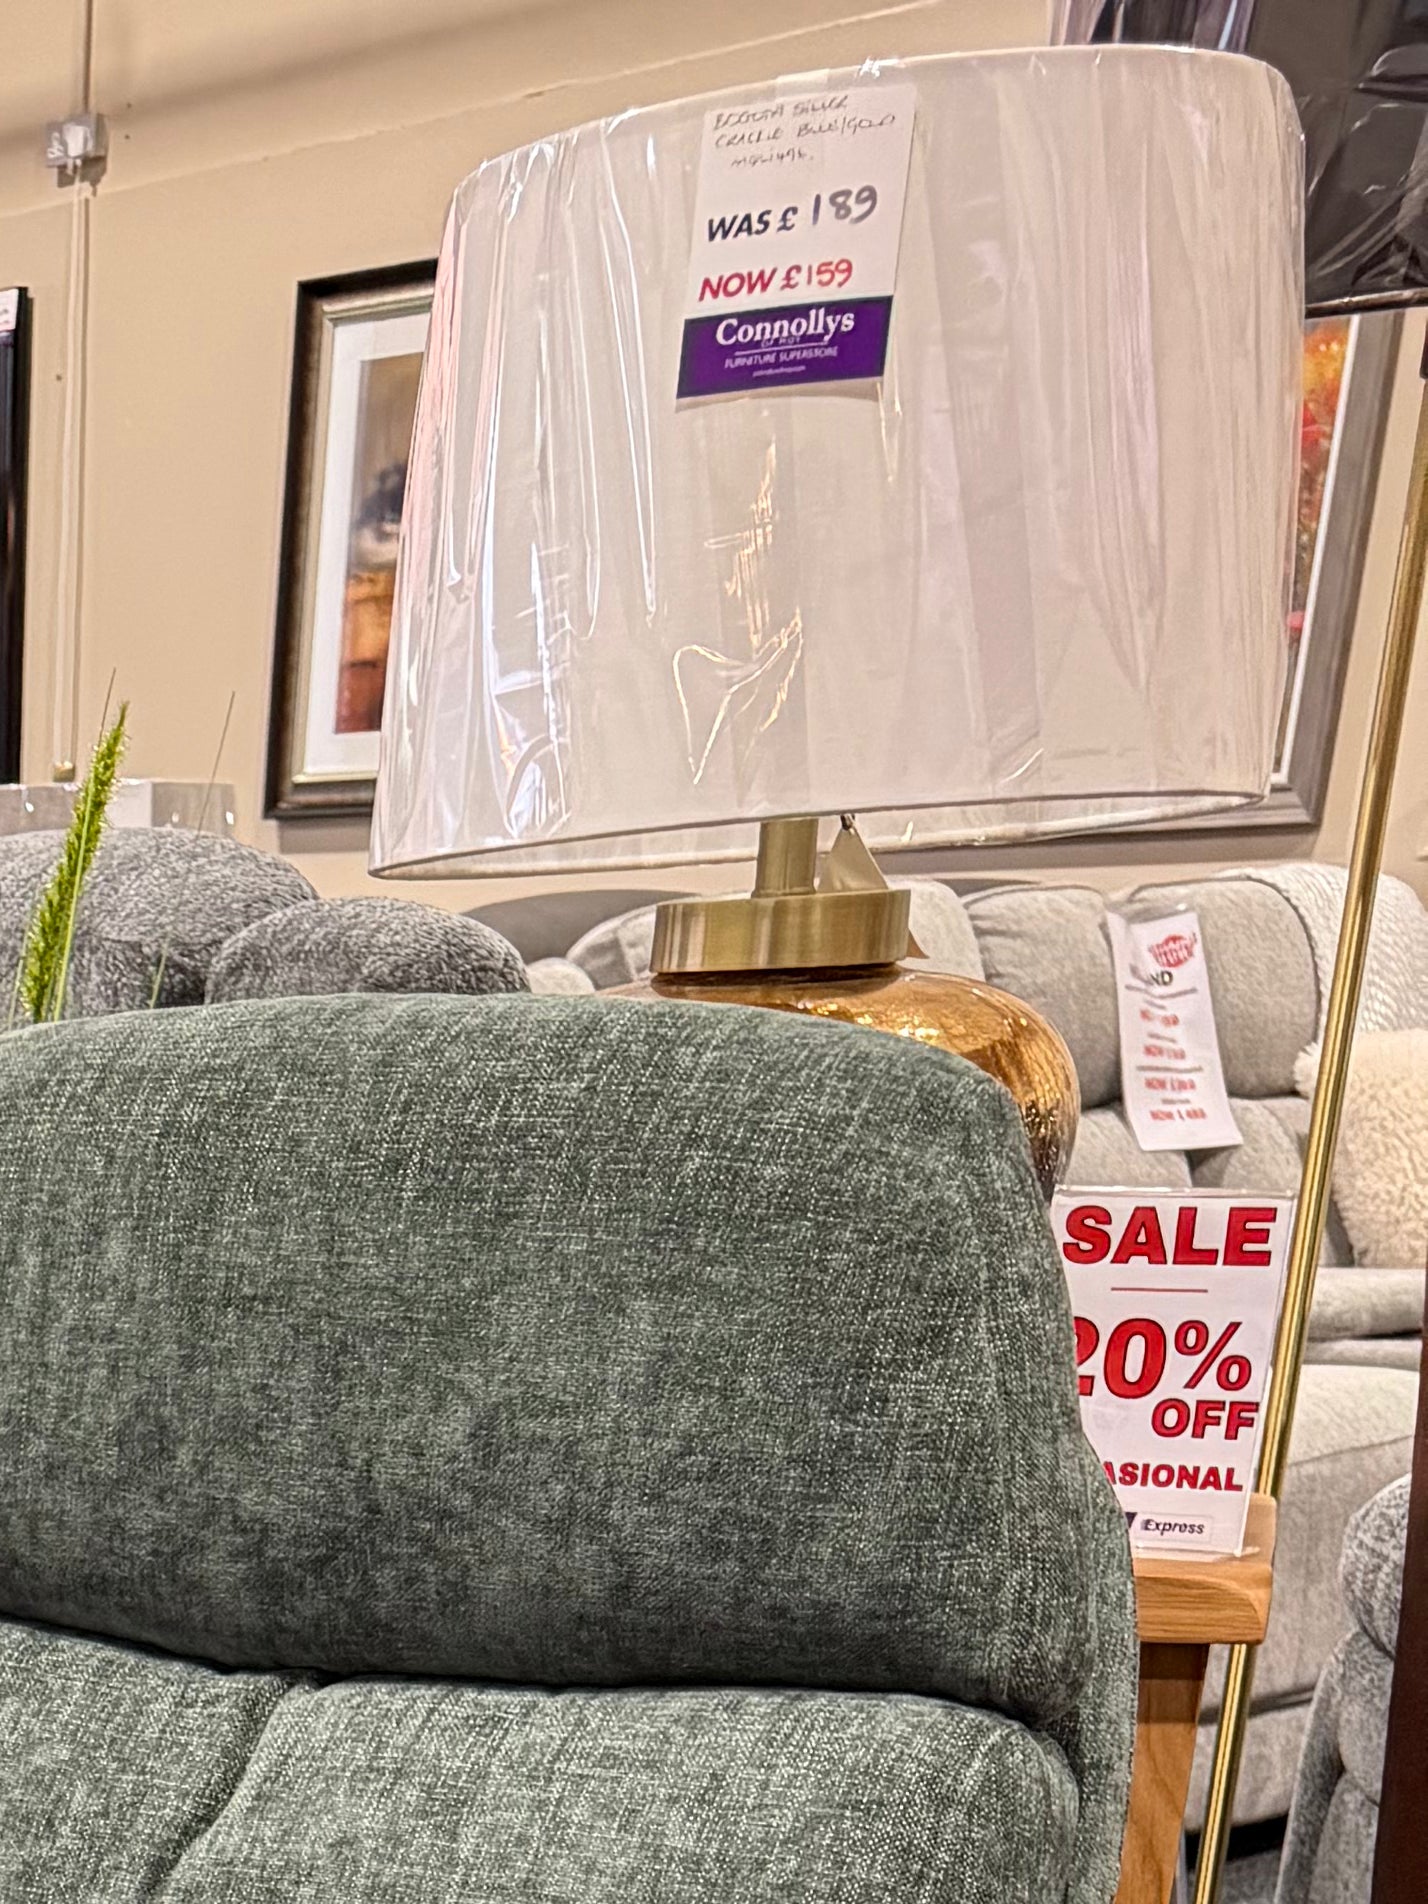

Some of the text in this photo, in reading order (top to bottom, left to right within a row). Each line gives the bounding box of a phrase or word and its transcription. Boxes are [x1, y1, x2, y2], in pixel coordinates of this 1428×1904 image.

[707, 209, 772, 242] WAS
[698, 267, 778, 301] NOW
[715, 307, 855, 346] Connollys
[1062, 1204, 1277, 1266] SALE
[1151, 1398, 1259, 1440] OFF
[1142, 1518, 1205, 1537] Express
